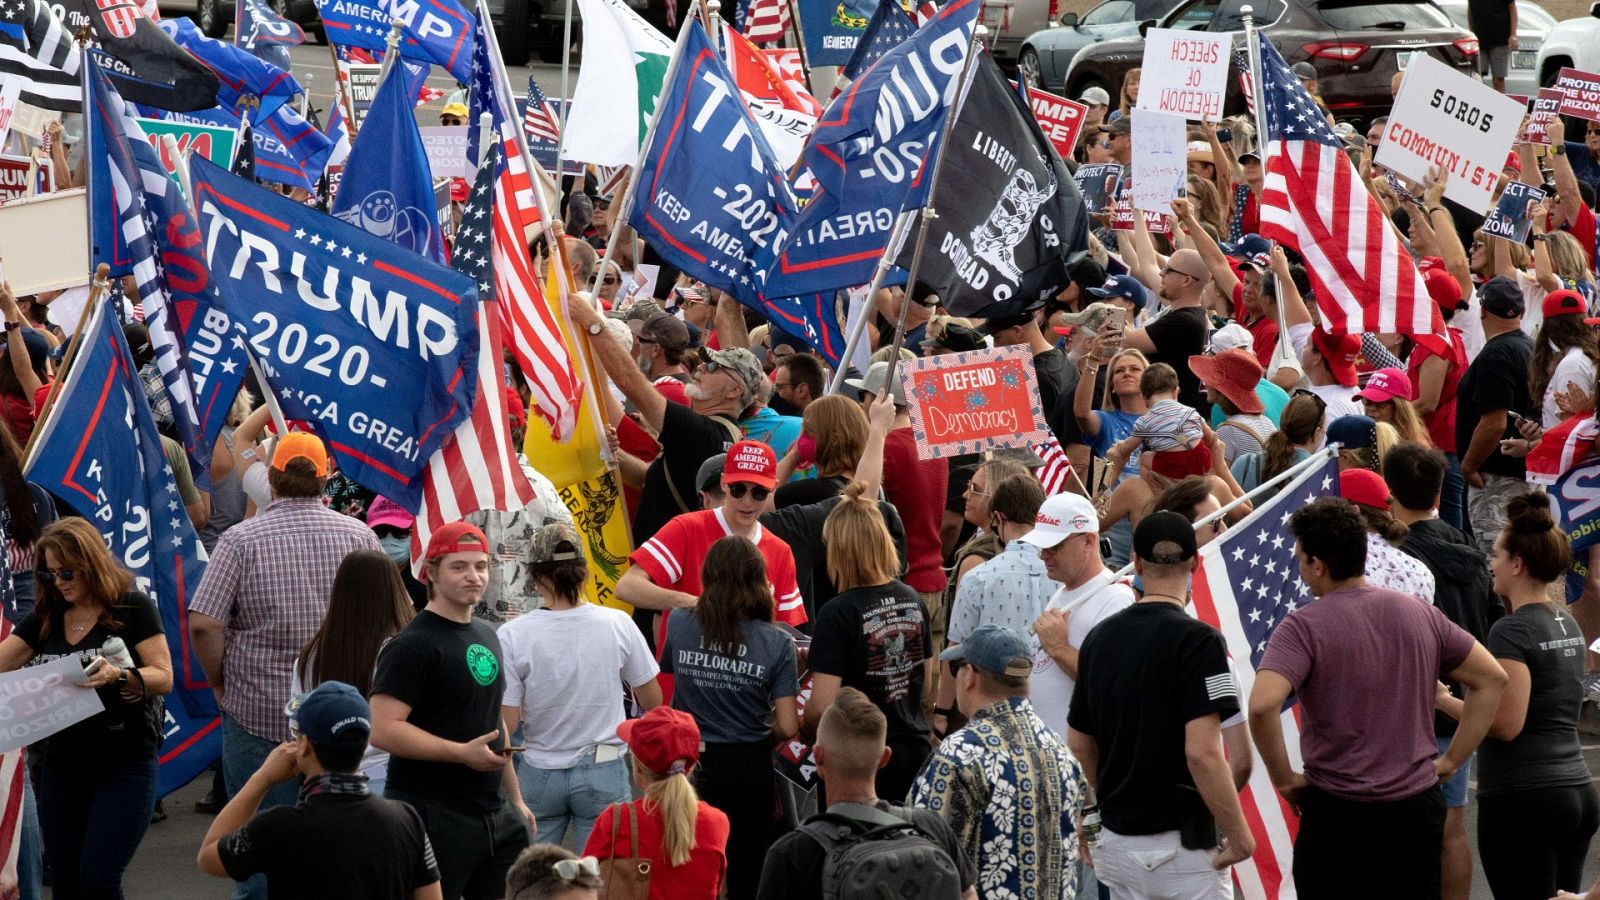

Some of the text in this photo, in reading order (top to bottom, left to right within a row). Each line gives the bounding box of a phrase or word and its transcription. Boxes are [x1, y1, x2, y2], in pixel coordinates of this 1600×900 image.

[69, 11, 90, 26] The
[1171, 41, 1219, 64] SPEECH
[1185, 67, 1202, 87] OF
[1160, 89, 1220, 116] FREEDOM
[1564, 88, 1579, 98] HE
[1431, 88, 1493, 133] SOROS
[253, 134, 293, 159] REA
[1389, 122, 1498, 192] COMMUNIST
[654, 187, 691, 224] KEEP
[1116, 212, 1161, 222] ARIZNA
[1039, 213, 1060, 249] OR
[202, 200, 459, 361] TRUMP
[943, 367, 997, 392] DEFEND
[928, 406, 1019, 437] Democracy
[733, 453, 770, 466] AMERICA
[742, 446, 764, 455] KEEP
[737, 462, 765, 472] GREAT
[678, 649, 766, 680] DEPLORABLE
[331, 716, 356, 734] DONALD
